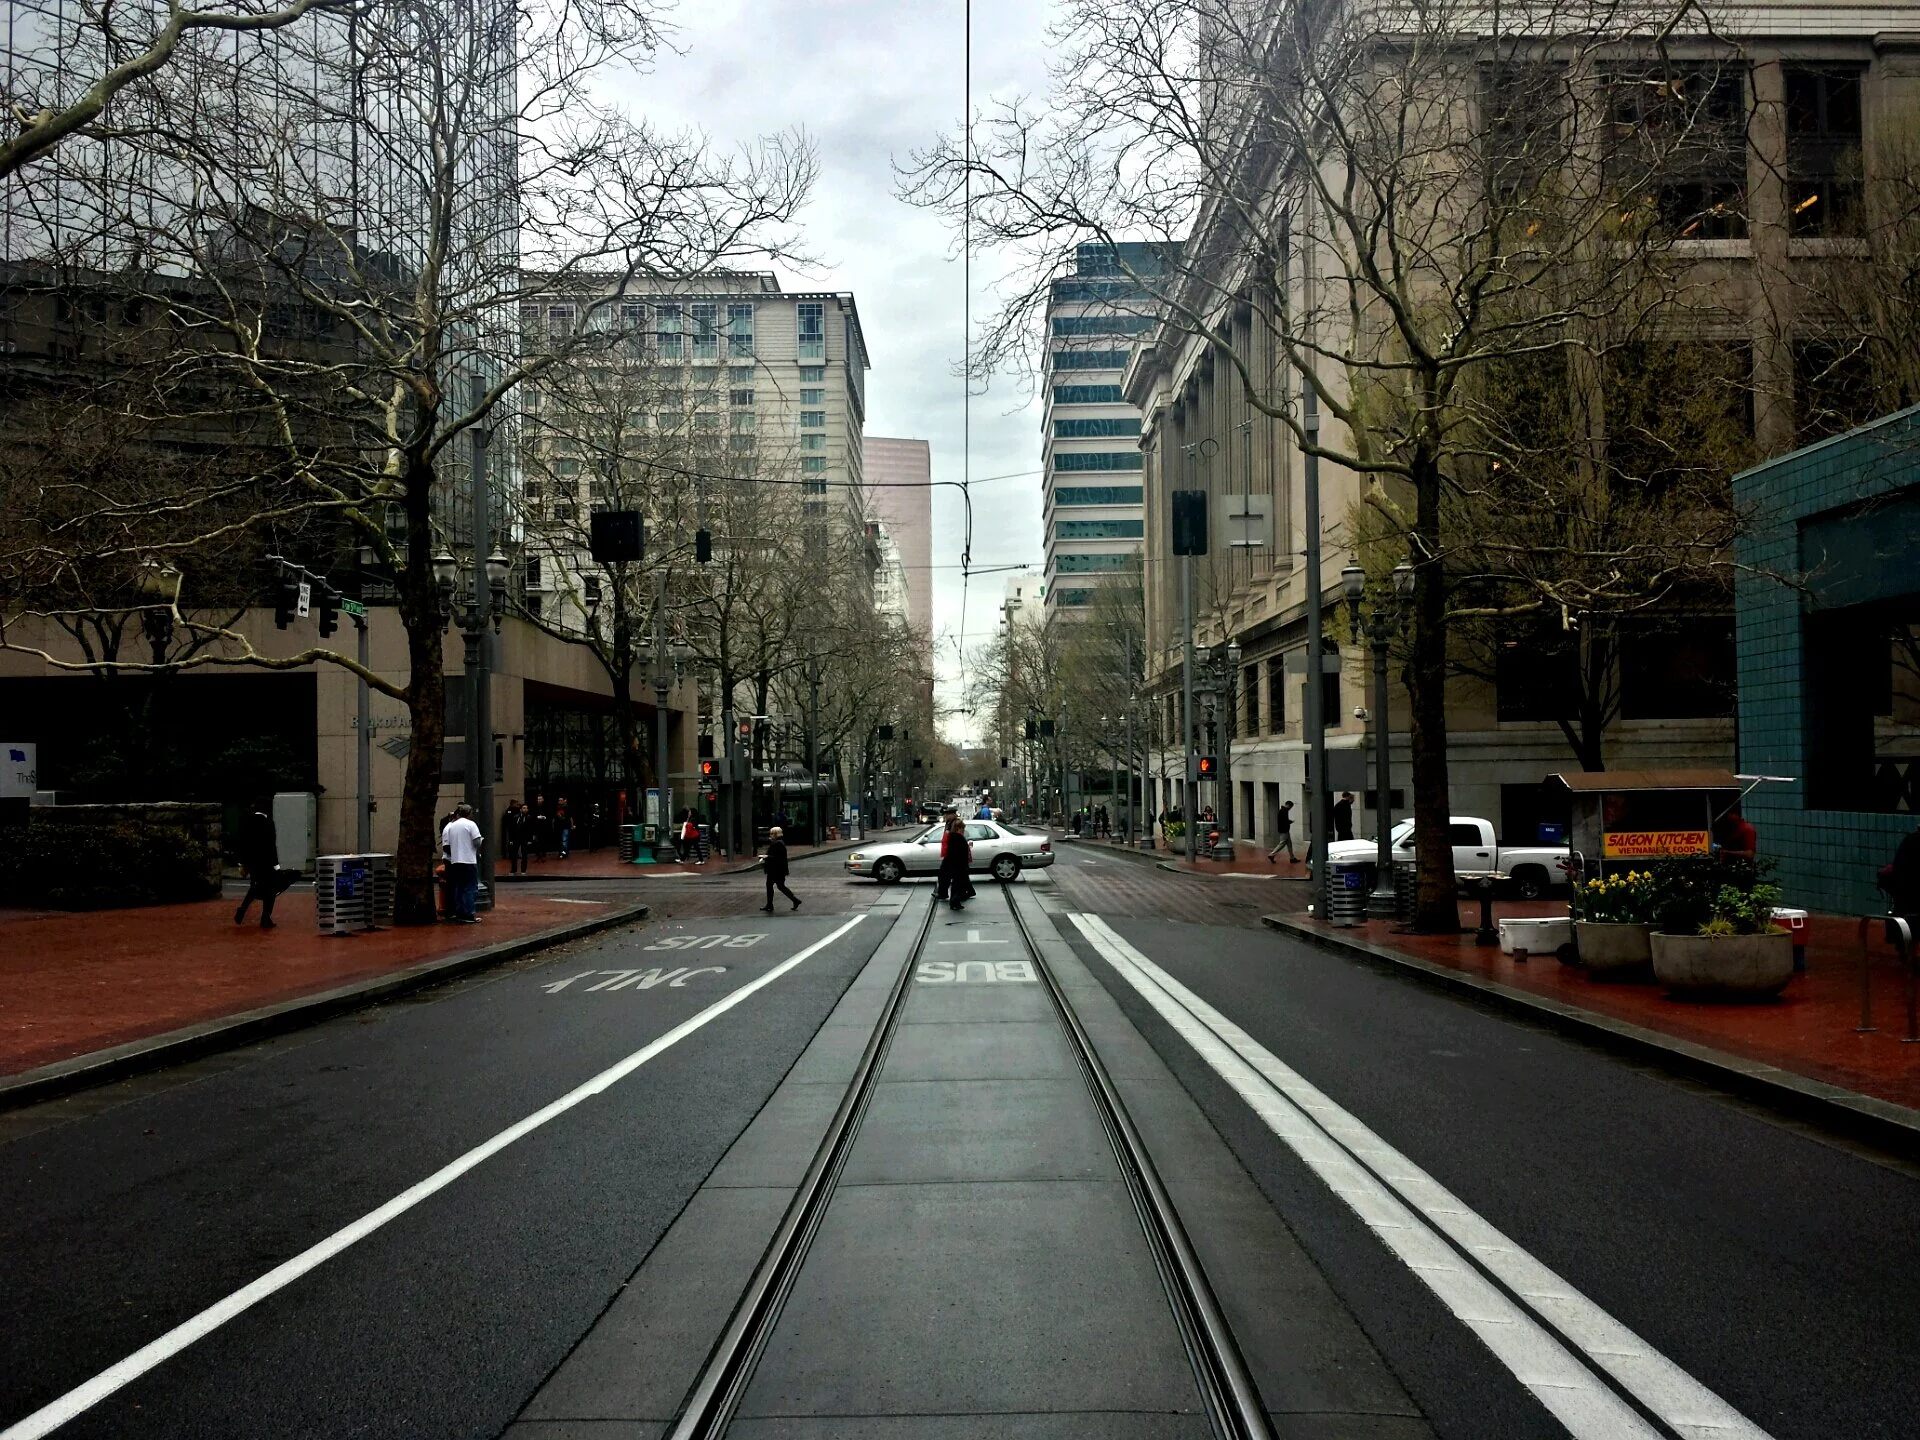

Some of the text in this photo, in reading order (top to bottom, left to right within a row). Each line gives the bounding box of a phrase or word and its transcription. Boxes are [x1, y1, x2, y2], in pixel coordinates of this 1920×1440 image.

[1608, 833, 1705, 846] SAIGON KITCHEN
[1672, 845, 1696, 854] FOOD
[643, 933, 770, 950] BUS
[915, 960, 1037, 982] BUS
